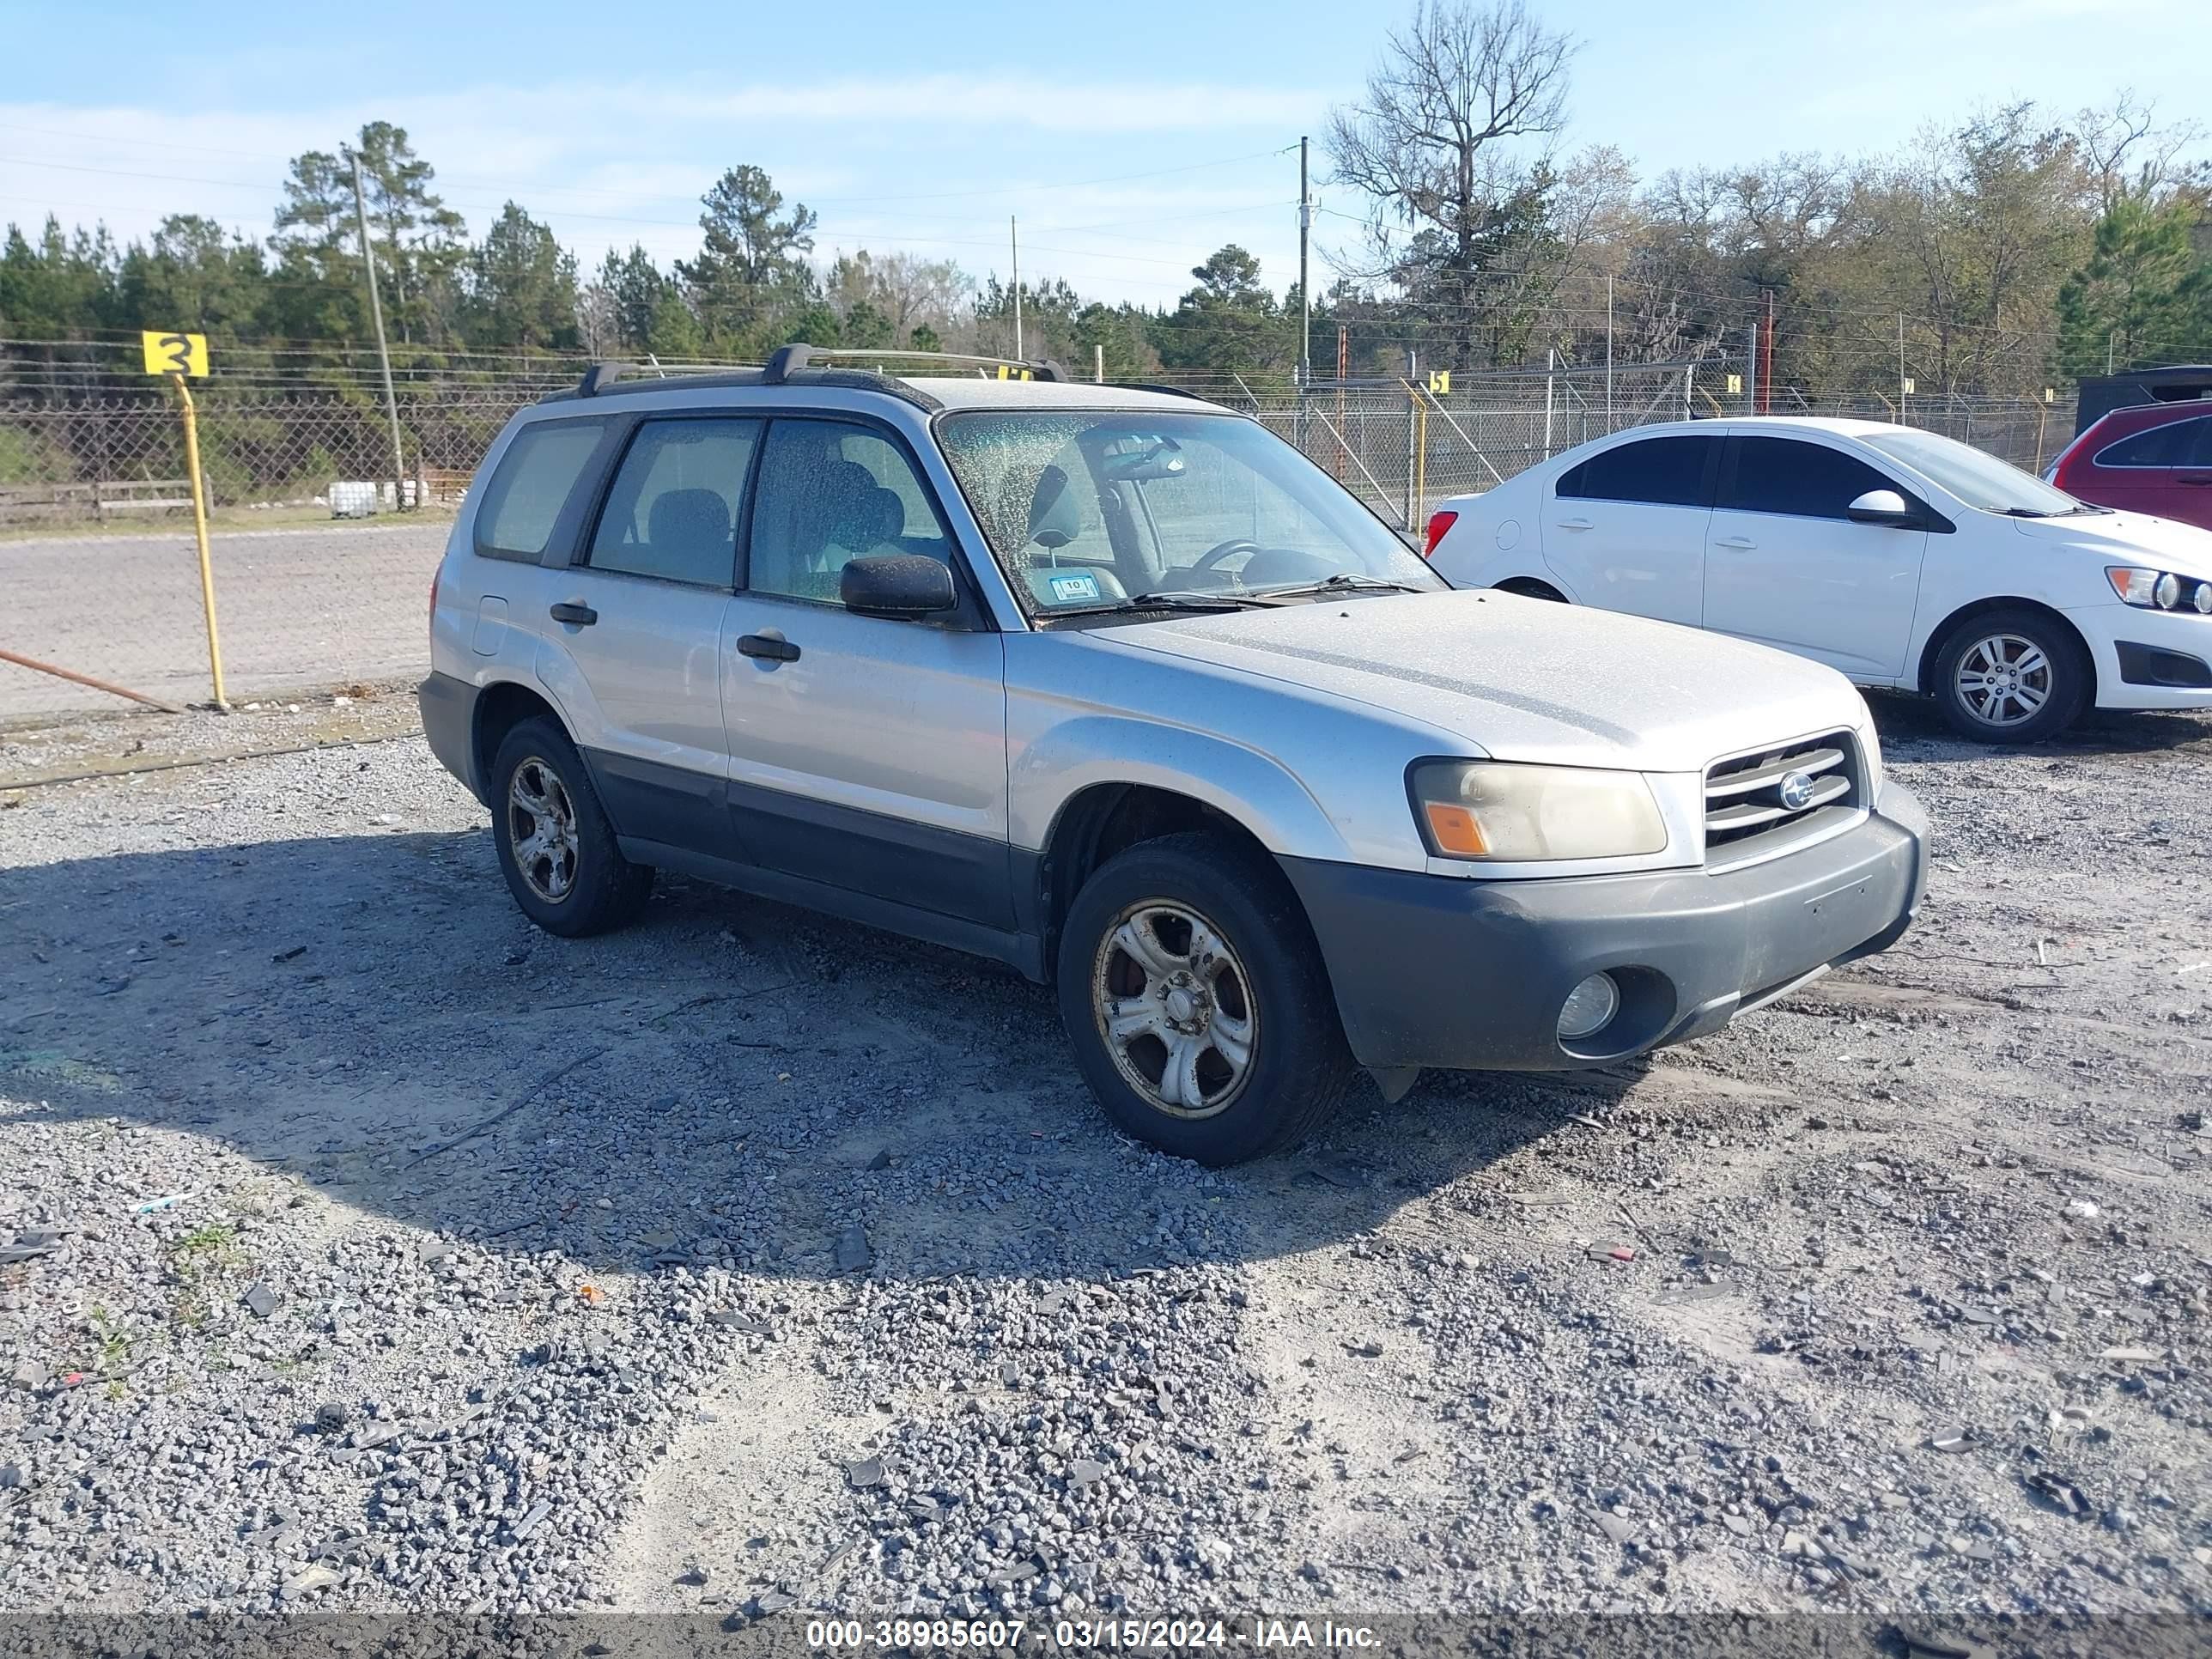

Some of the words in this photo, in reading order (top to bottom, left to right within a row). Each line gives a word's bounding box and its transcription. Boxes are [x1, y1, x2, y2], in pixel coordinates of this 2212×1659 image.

[159, 334, 192, 376] 3
[1433, 370, 1443, 392] 5
[1731, 375, 1737, 392] 6
